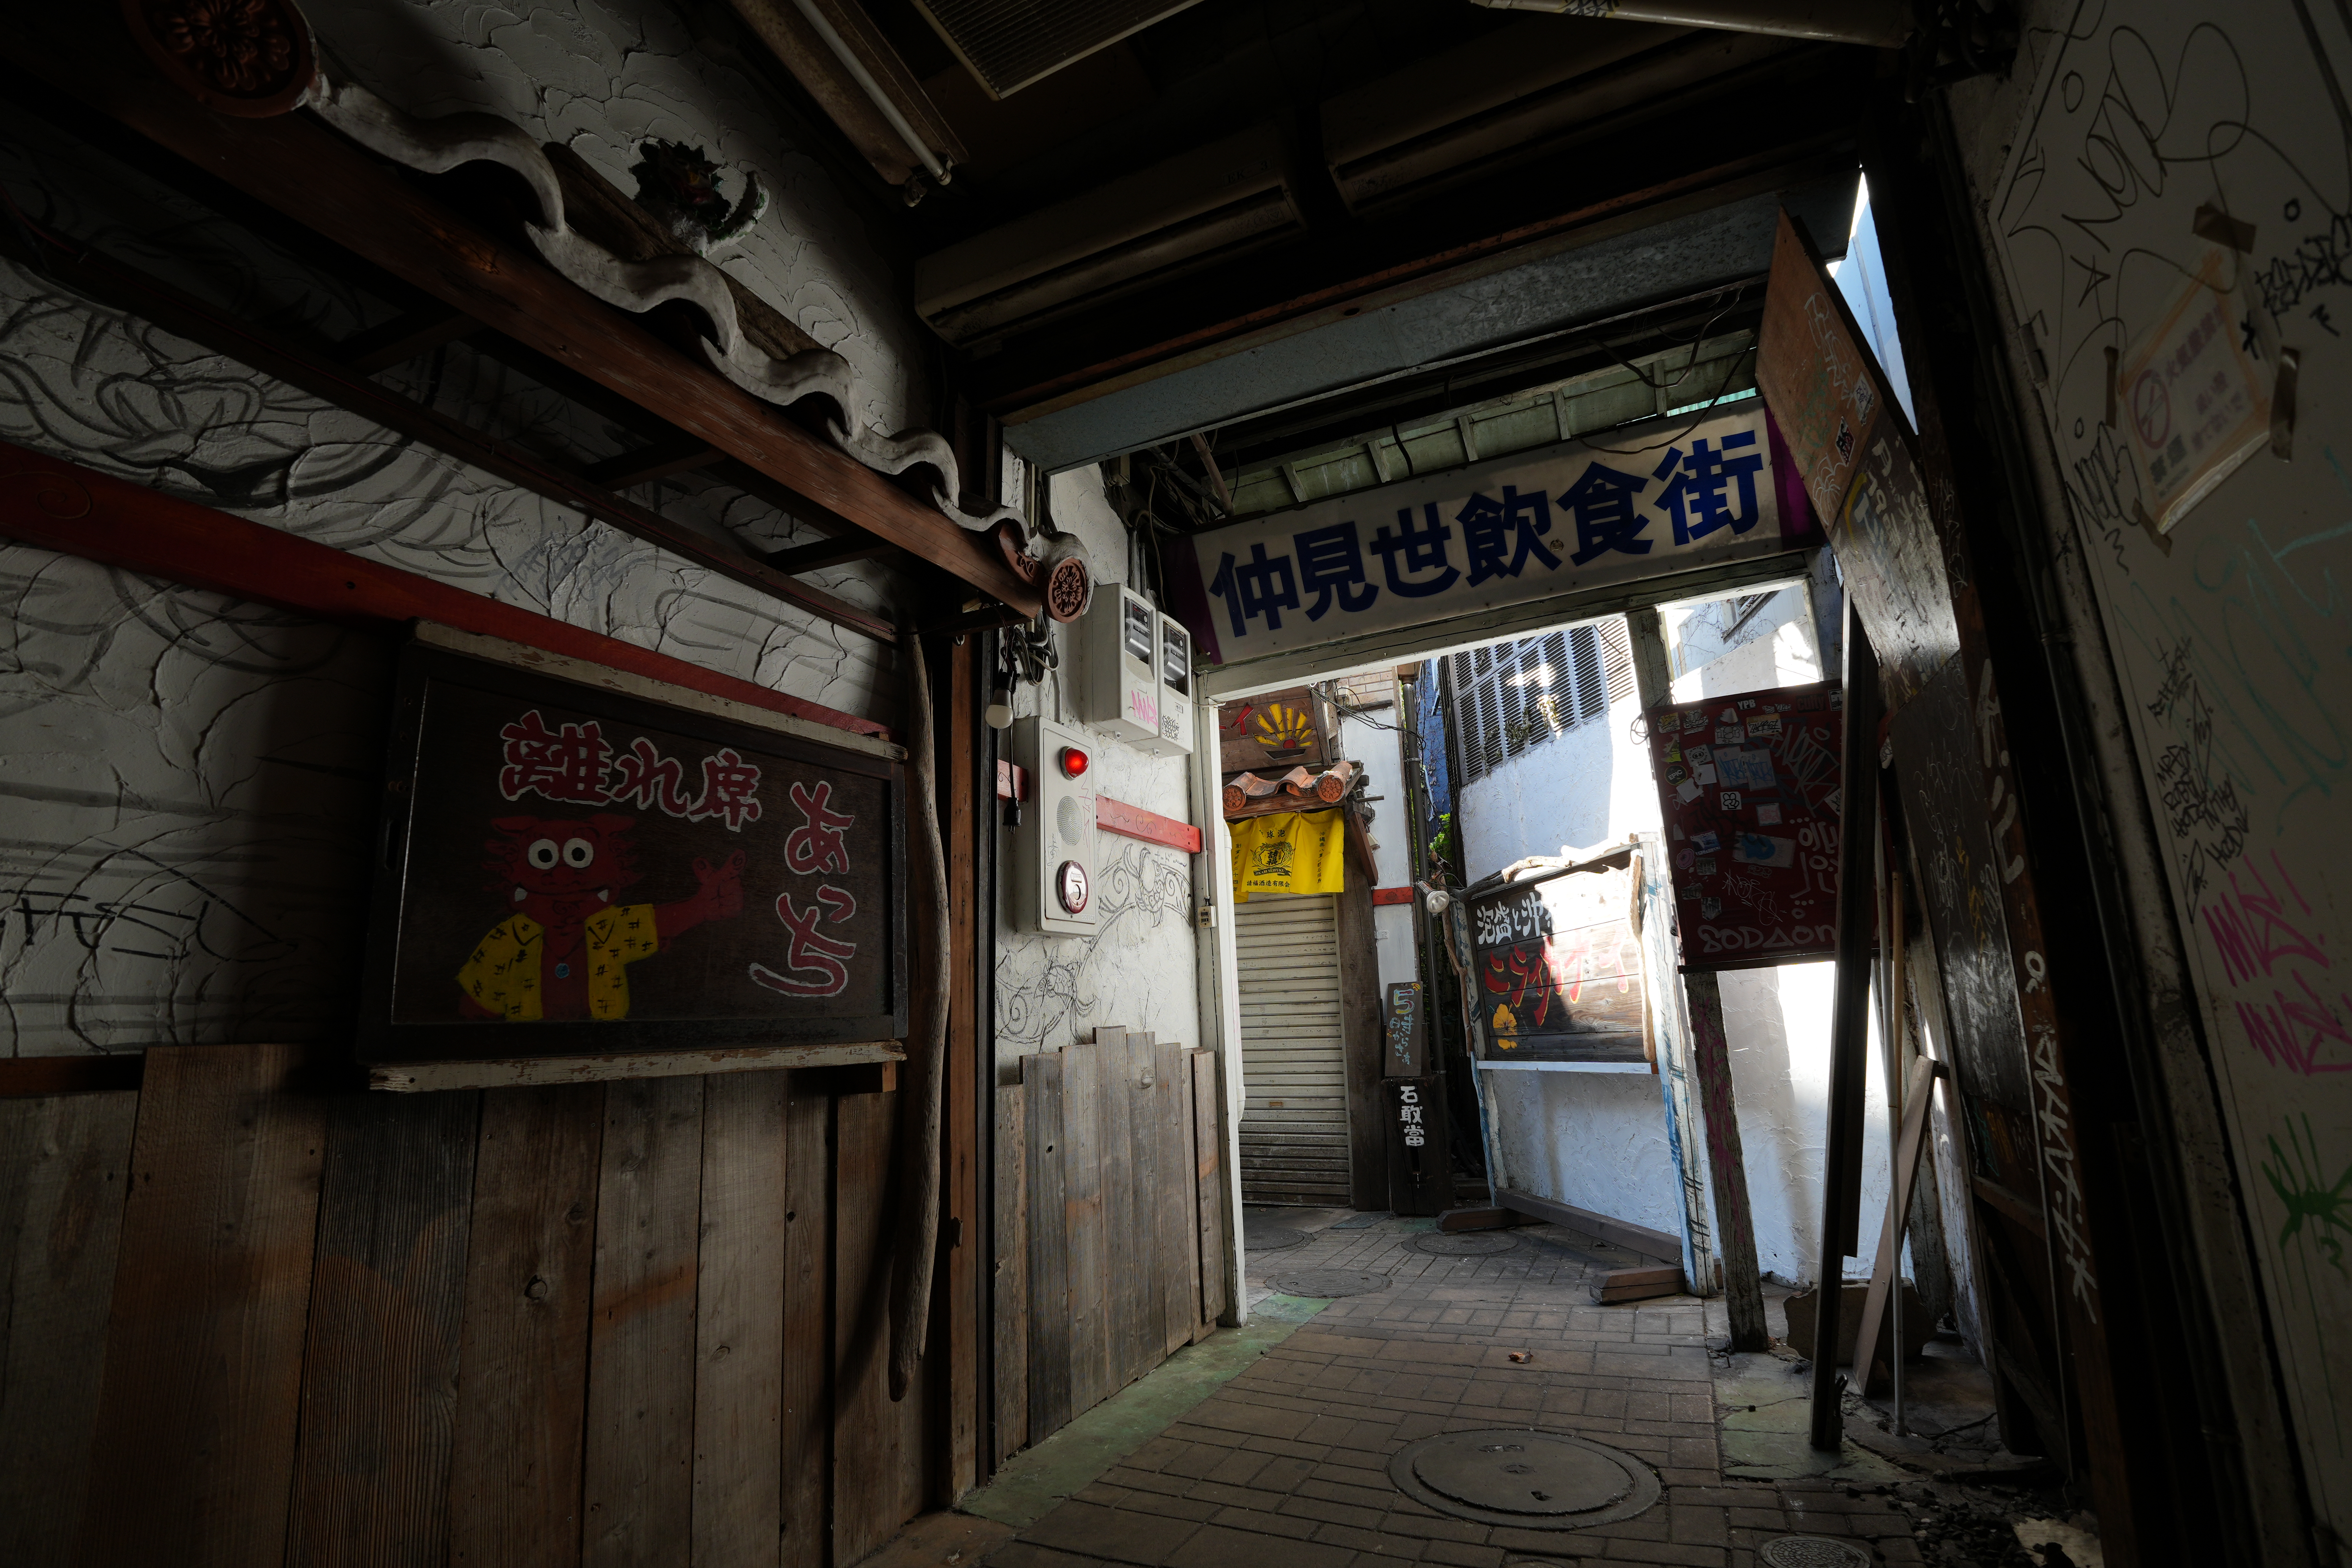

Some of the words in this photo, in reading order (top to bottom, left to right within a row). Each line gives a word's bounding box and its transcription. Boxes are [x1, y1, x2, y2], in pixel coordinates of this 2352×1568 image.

[1209, 429, 1763, 638] 仲見世飲食街
[1737, 699, 1756, 710] YPB
[499, 710, 761, 832] 離れ席
[1668, 770, 1683, 780] EPIC
[749, 780, 857, 997] あっち
[1399, 1086, 1425, 1147] 石敢當
